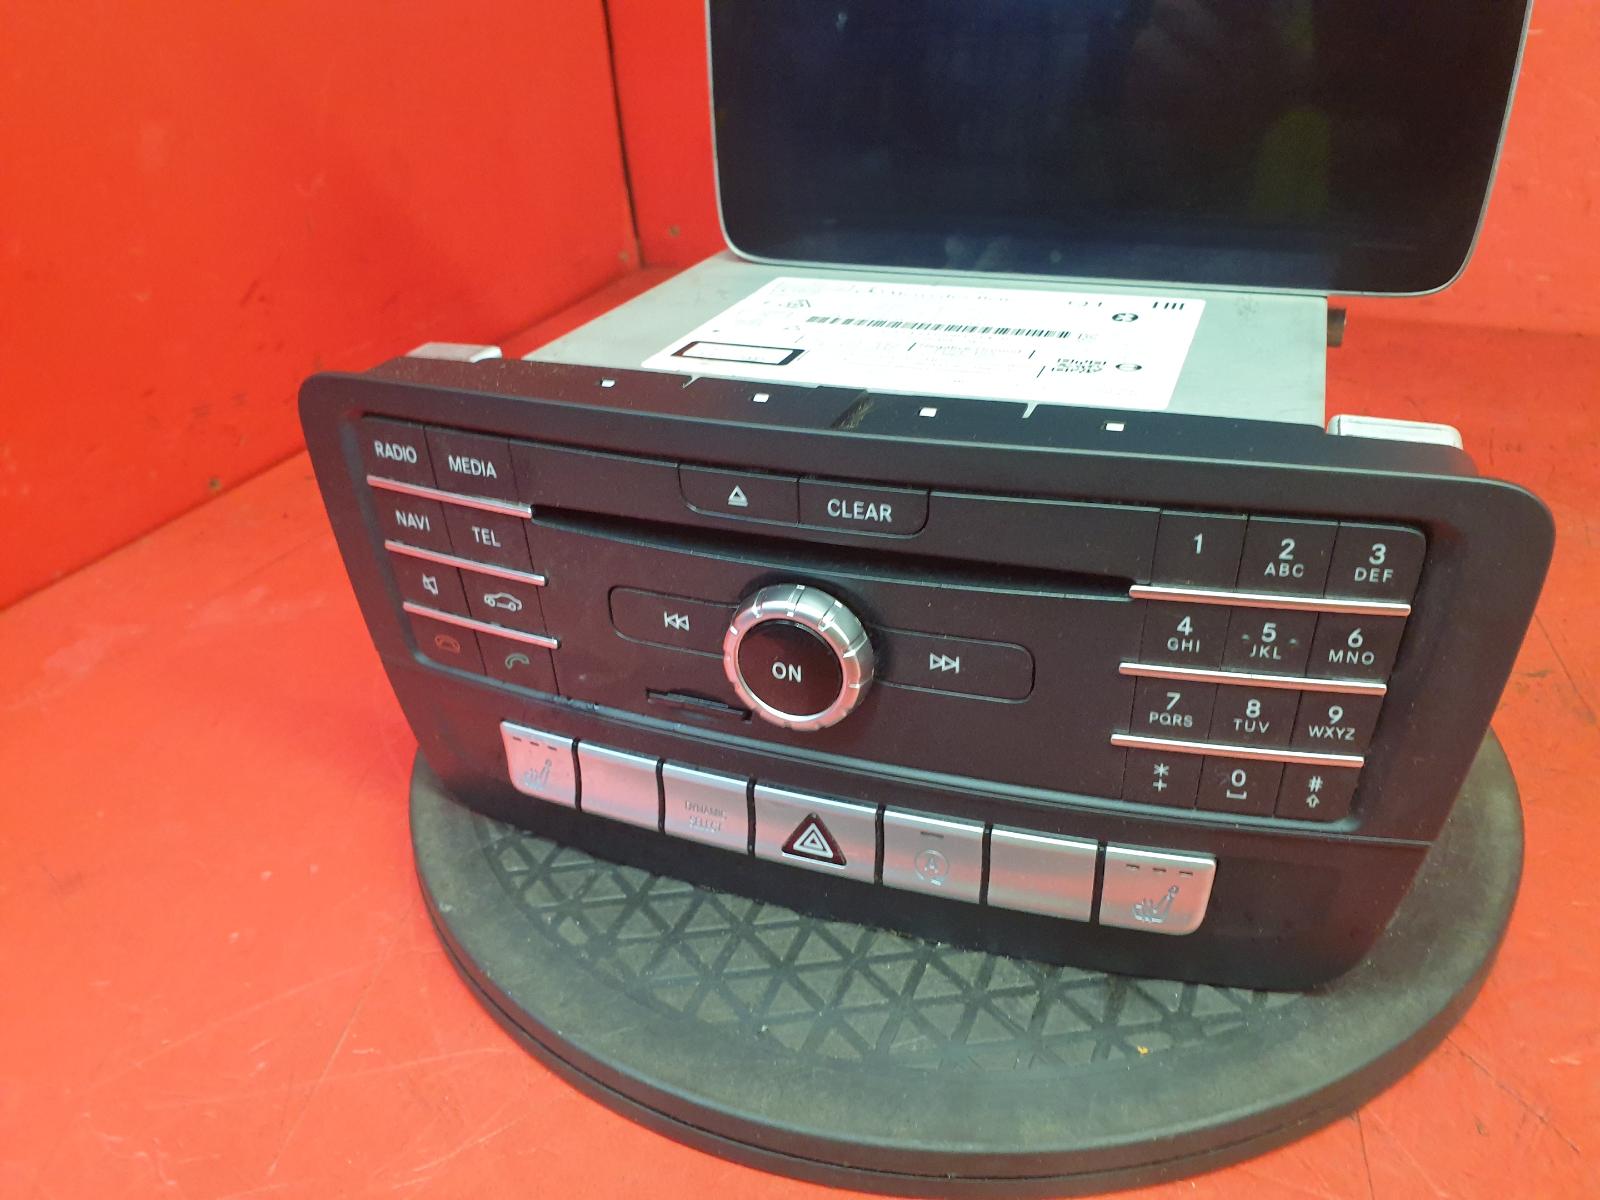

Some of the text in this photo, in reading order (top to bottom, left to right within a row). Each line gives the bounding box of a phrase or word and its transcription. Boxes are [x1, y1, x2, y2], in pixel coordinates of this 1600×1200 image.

[374, 440, 417, 464] RADIO
[448, 455, 497, 479] MEDIA
[827, 498, 892, 522] CLEAR
[395, 510, 431, 532] NAVI
[471, 526, 501, 548] TEL
[1193, 533, 1203, 554] 1
[1278, 538, 1296, 560] 2
[1368, 543, 1387, 565] 3
[1264, 562, 1304, 578] ABC
[1354, 567, 1393, 583] DEF
[1176, 616, 1193, 636] 4
[1261, 622, 1277, 643] 5
[1167, 638, 1200, 653] GHI
[1347, 628, 1364, 649] 6
[1250, 644, 1282, 660] JKL
[1328, 649, 1375, 665] MNO
[771, 661, 802, 683] ON
[1166, 692, 1181, 710] 7
[1245, 699, 1261, 718] 8
[1149, 711, 1193, 728] PQRS
[1328, 705, 1344, 725] 9
[1233, 718, 1270, 734] TUV
[1308, 725, 1356, 741] WXYZ
[1231, 769, 1246, 787] 0
